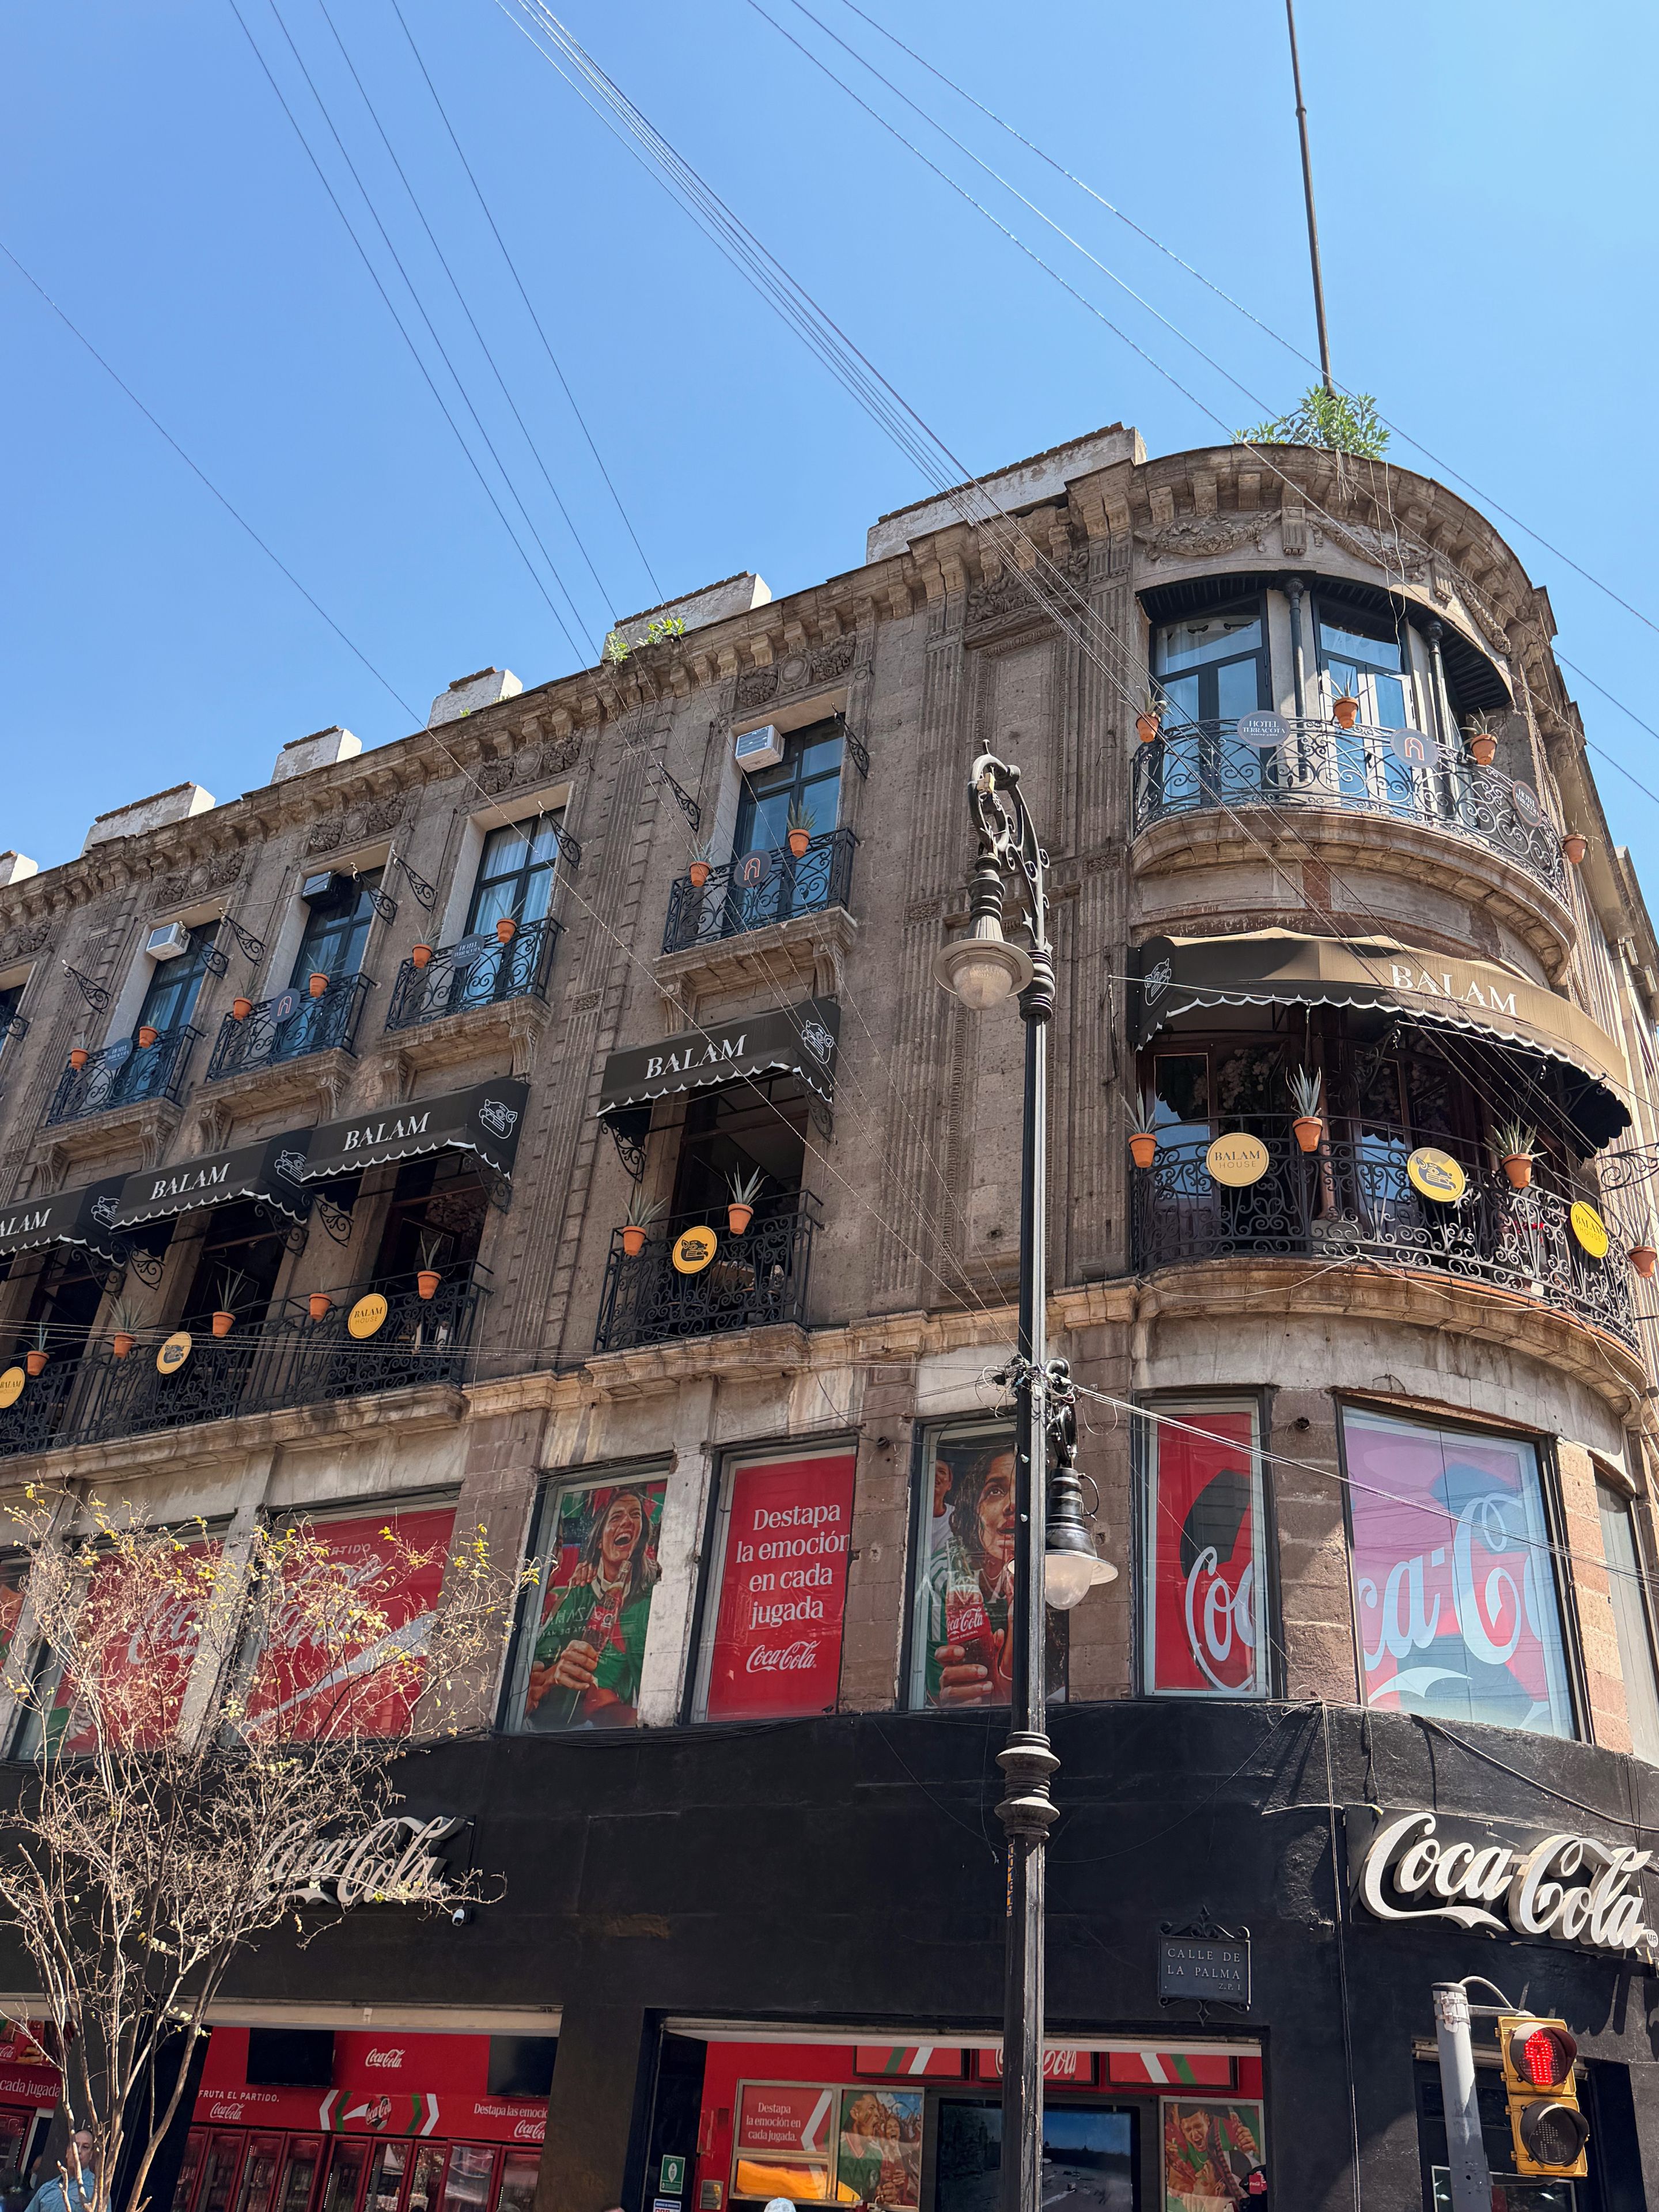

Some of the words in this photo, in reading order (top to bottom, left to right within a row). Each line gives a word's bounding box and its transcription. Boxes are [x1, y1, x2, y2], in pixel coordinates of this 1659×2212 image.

[1388, 964, 1519, 1017] BALAM
[643, 1033, 748, 1080] BALAM
[342, 1111, 431, 1152] BALAM
[1214, 1150, 1260, 1161] BALAM
[1219, 1160, 1256, 1169] HOUSE
[149, 1162, 231, 1200] BALAM
[1575, 1214, 1603, 1236] BALAM
[1580, 1226, 1602, 1243] HOUSE
[354, 1306, 383, 1319] BALAM
[355, 1316, 378, 1324] HOUSE
[752, 1503, 841, 1531] Destapa
[330, 1543, 371, 1555] RTIDO
[736, 1541, 754, 1563] la
[758, 1530, 850, 1559] emoción
[749, 1573, 775, 1592] en
[779, 1563, 833, 1589] cada
[749, 1595, 824, 1630] jugada
[746, 1640, 821, 1673] Coca-Cola
[1359, 1812, 1653, 1949] Coca-Cola
[1168, 1948, 1213, 1960] CALLE
[1223, 1952, 1240, 1962] DE
[1168, 1965, 1184, 1975] LA
[1195, 1967, 1240, 1980] PALMA
[365, 2048, 406, 2068] Coca-Cola
[0, 2078, 25, 2093] cada
[25, 2080, 61, 2098] jugada
[198, 2090, 224, 2099] FRUTA
[227, 2091, 237, 2099] EL
[240, 2092, 279, 2103] PARTIDO.
[209, 2102, 245, 2120] Coca-Cola
[474, 2103, 506, 2118] Destapa
[506, 2105, 518, 2117] las
[757, 2102, 791, 2116] Destapa
[746, 2115, 753, 2126] la
[755, 2116, 789, 2128] emoción
[790, 2119, 801, 2128] en
[748, 2129, 768, 2140] cada
[767, 2130, 797, 2142] jugada.
